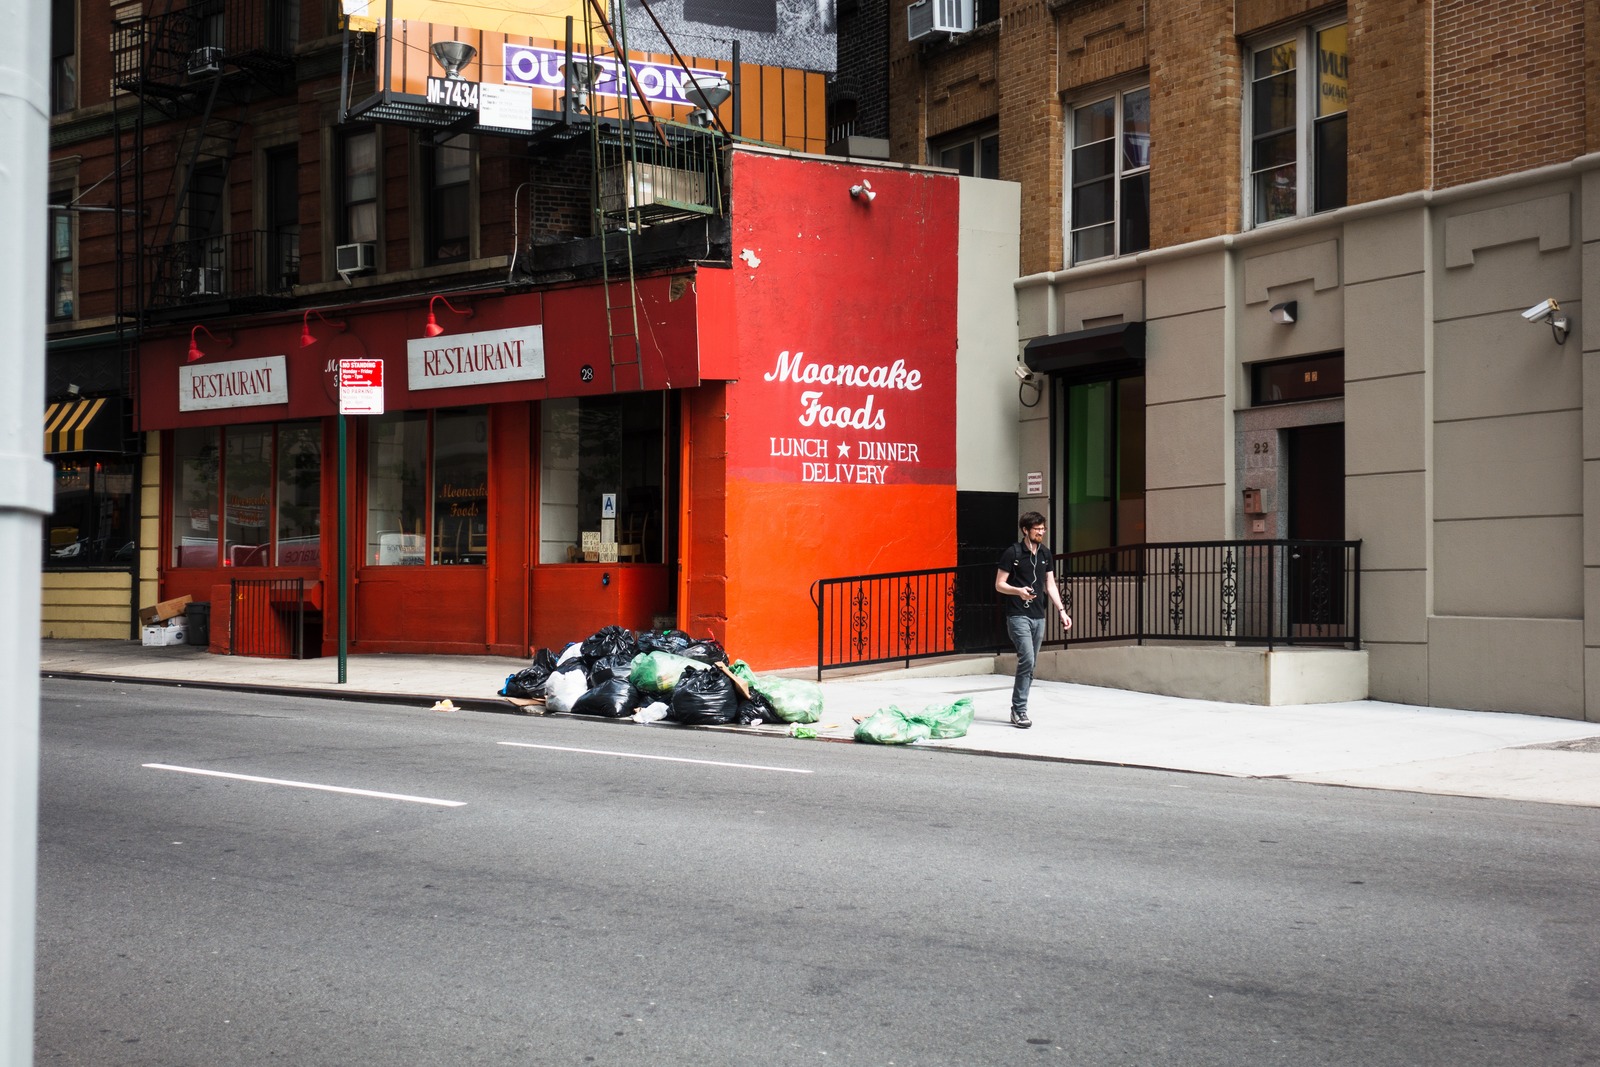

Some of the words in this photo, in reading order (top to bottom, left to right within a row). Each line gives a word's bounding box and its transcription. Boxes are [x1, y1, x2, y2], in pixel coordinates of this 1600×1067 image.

[511, 50, 720, 100] OUFRON
[427, 78, 478, 109] M-7434
[423, 340, 525, 376] RESTAURANT
[764, 351, 922, 391] Mooncake
[192, 368, 272, 399] RESTAURANT
[582, 368, 593, 380] 28
[799, 391, 886, 430] Foods
[769, 437, 829, 458] LUNCH
[858, 441, 920, 462] DINNER
[1254, 442, 1268, 454] 22
[802, 462, 889, 484] DELIVERY
[450, 502, 479, 517] Foods
[604, 496, 614, 511] A
